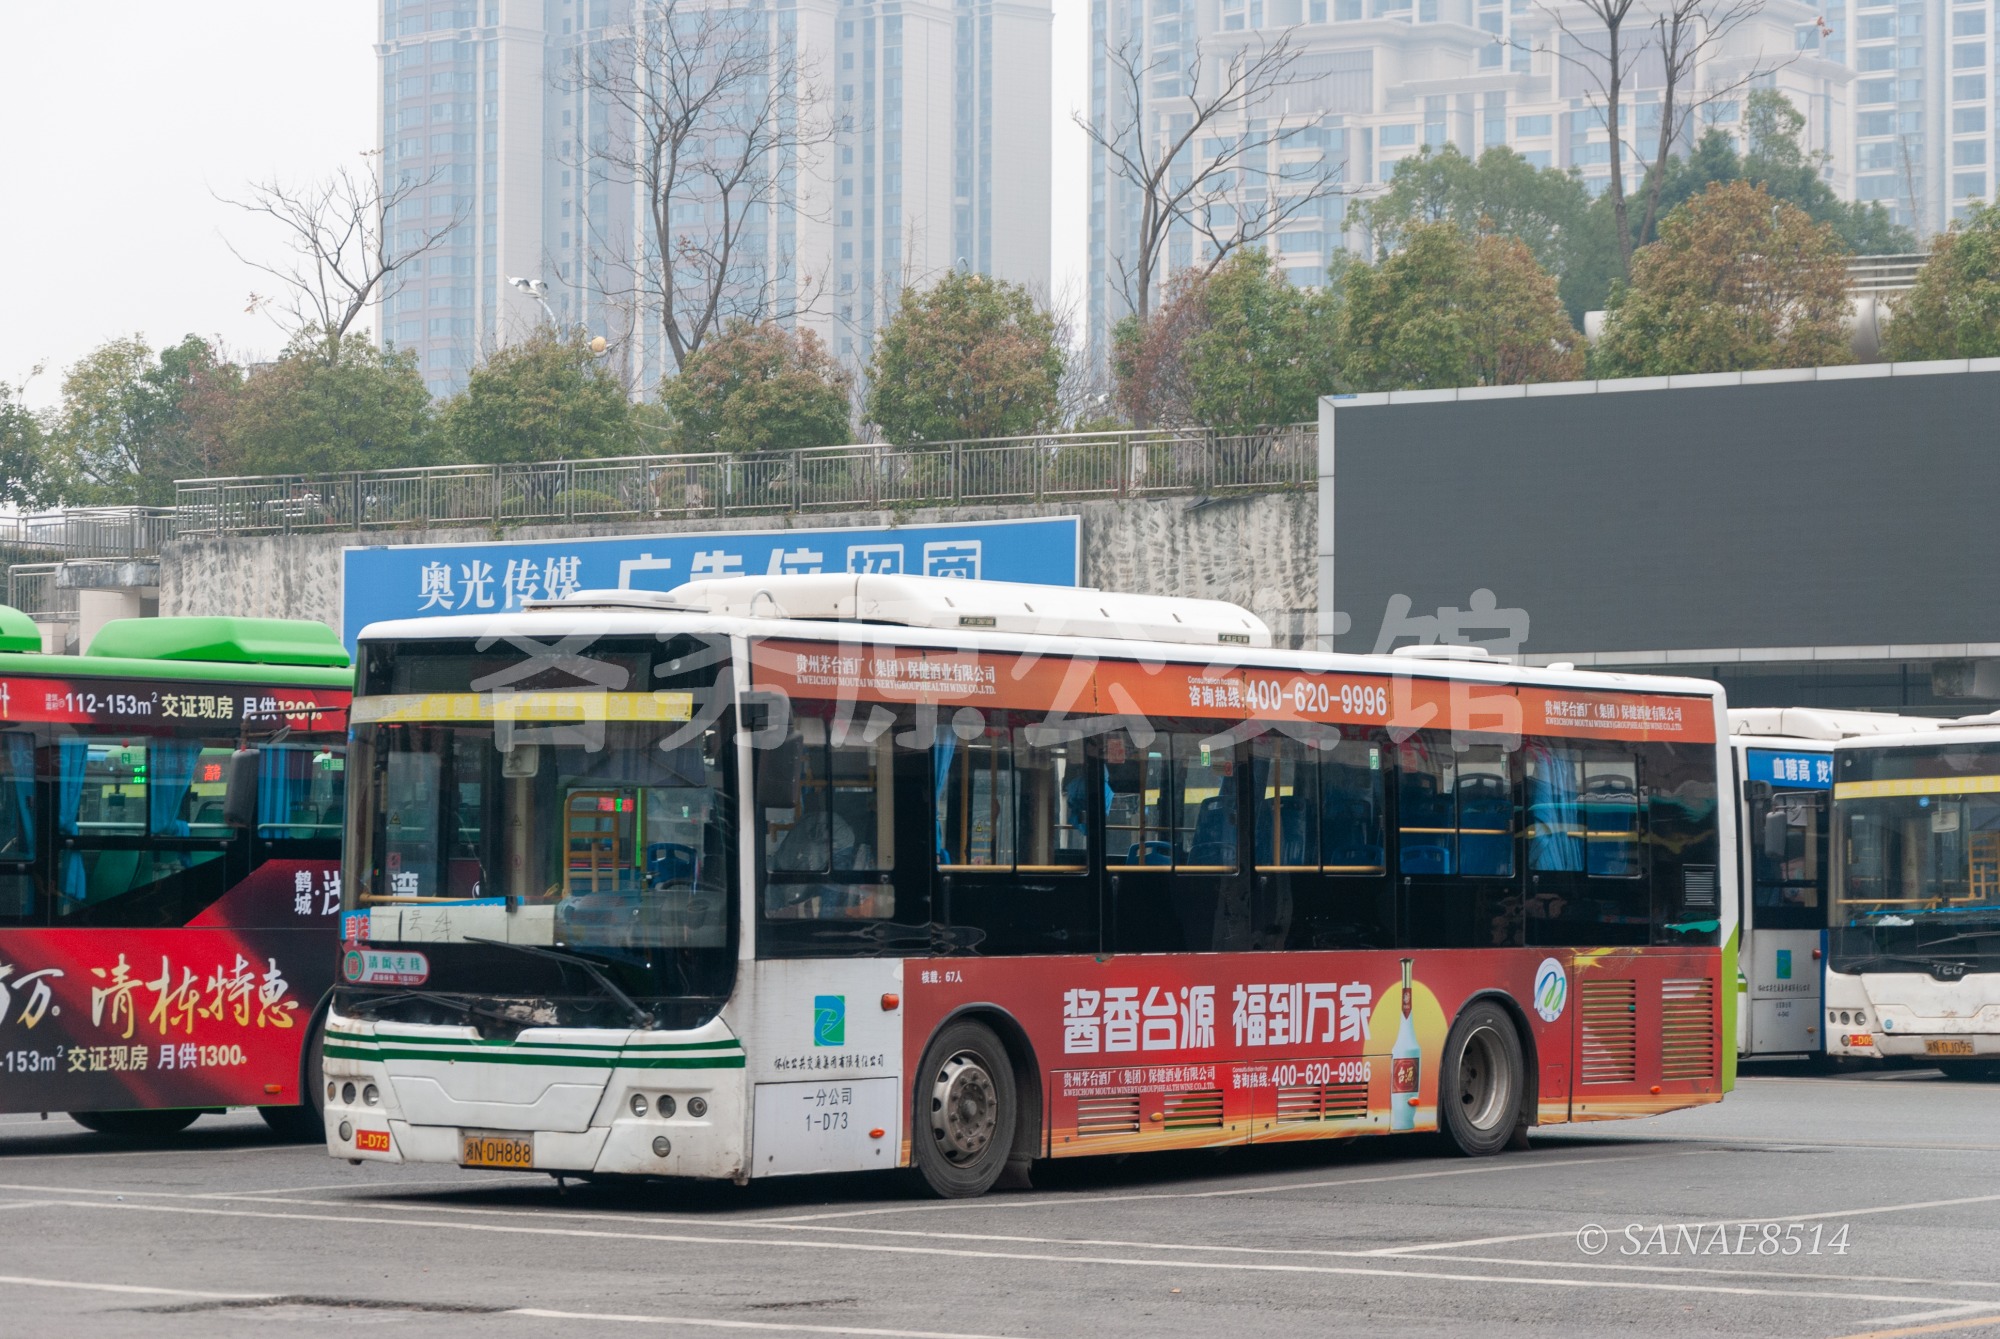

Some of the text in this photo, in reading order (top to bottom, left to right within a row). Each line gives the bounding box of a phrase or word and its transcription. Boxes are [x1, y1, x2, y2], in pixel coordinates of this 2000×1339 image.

[417, 556, 582, 611] 奥光传媒
[797, 675, 838, 686] KWEICHOW
[161, 694, 233, 719] 交证现房
[1246, 680, 1387, 716] 400-620-9996
[1773, 757, 1833, 783] 血糖高 找
[1063, 981, 1372, 1054] 酱香台源 福到万家
[67, 1044, 148, 1073] 交证现房
[1272, 1061, 1371, 1087] 400-620-9996
[803, 1087, 852, 1106] 一分公司
[806, 1111, 848, 1131] 1-D73
[357, 1133, 388, 1149] 1-D73
